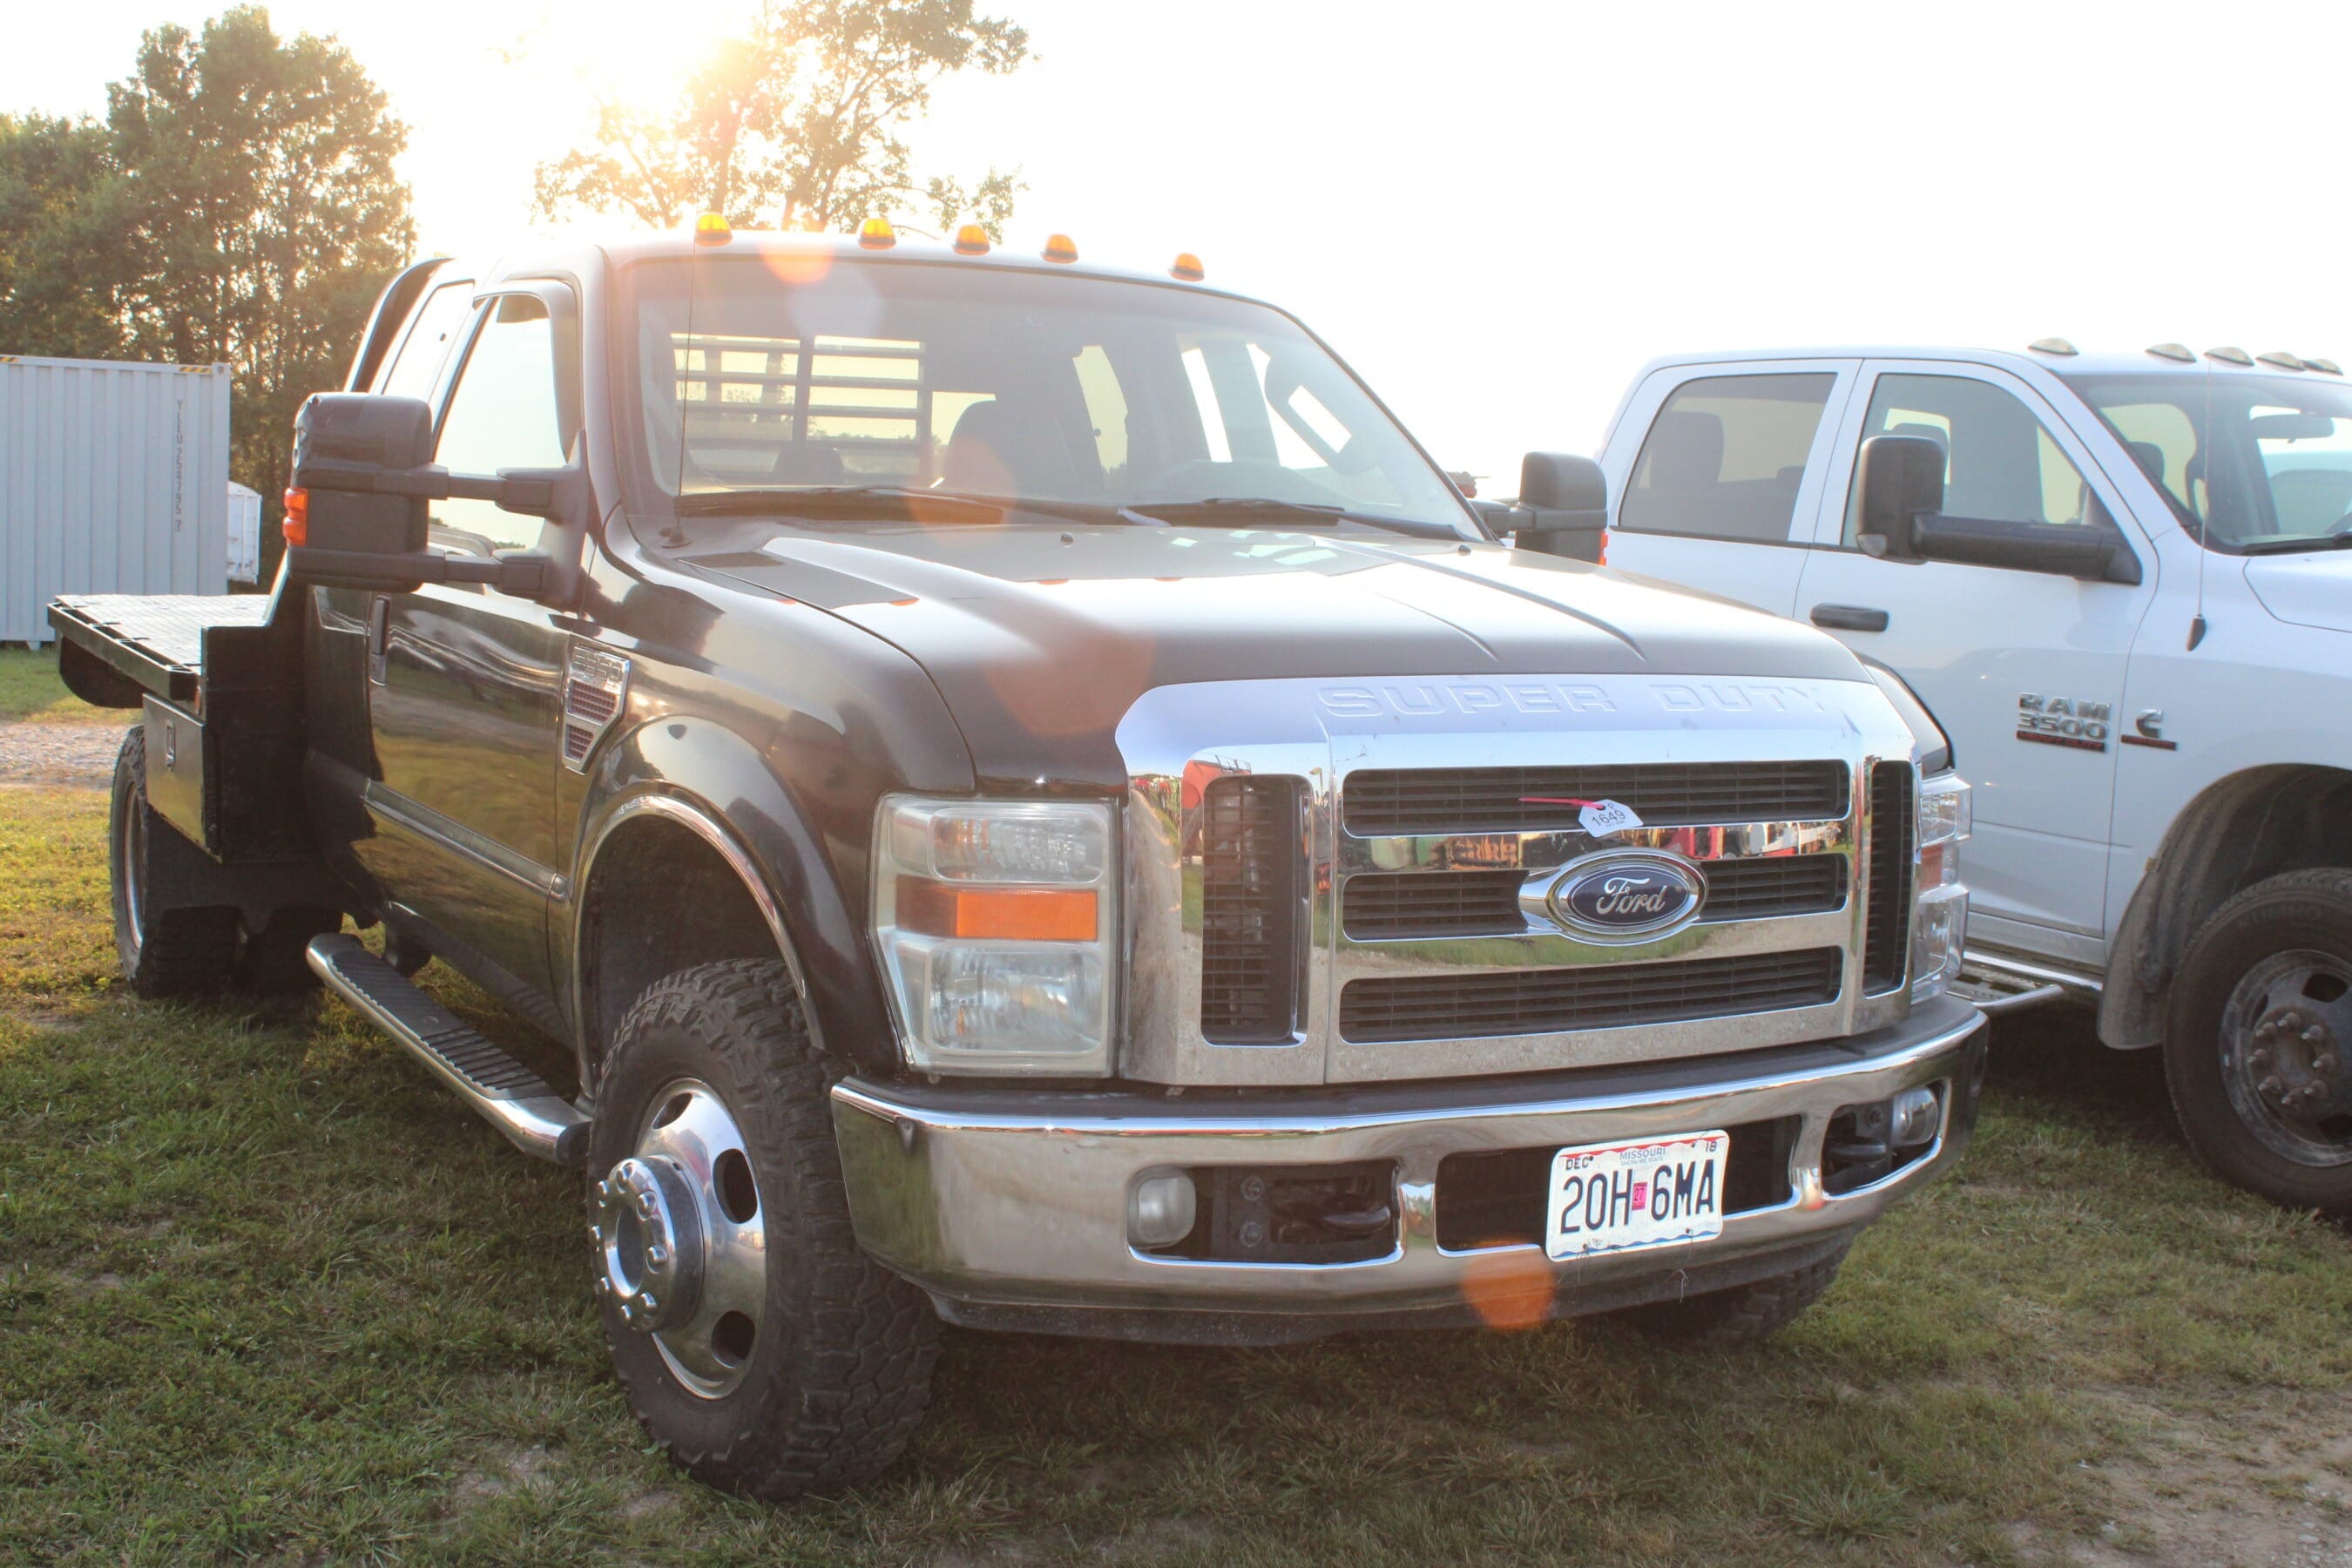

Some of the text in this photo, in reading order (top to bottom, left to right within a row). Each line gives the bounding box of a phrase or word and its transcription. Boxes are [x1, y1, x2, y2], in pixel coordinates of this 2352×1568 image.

[1316, 683, 1827, 718] SUPER DUTY
[2018, 692, 2112, 721] RAM
[2017, 710, 2108, 740] 3500
[1592, 809, 1626, 827] 1649
[1596, 876, 1668, 915] Ford
[1619, 1147, 1666, 1160] MISSOURI
[1705, 1140, 1718, 1152] 18
[1565, 1157, 1590, 1171] DEC
[1560, 1159, 1714, 1234] 20H 6MA
